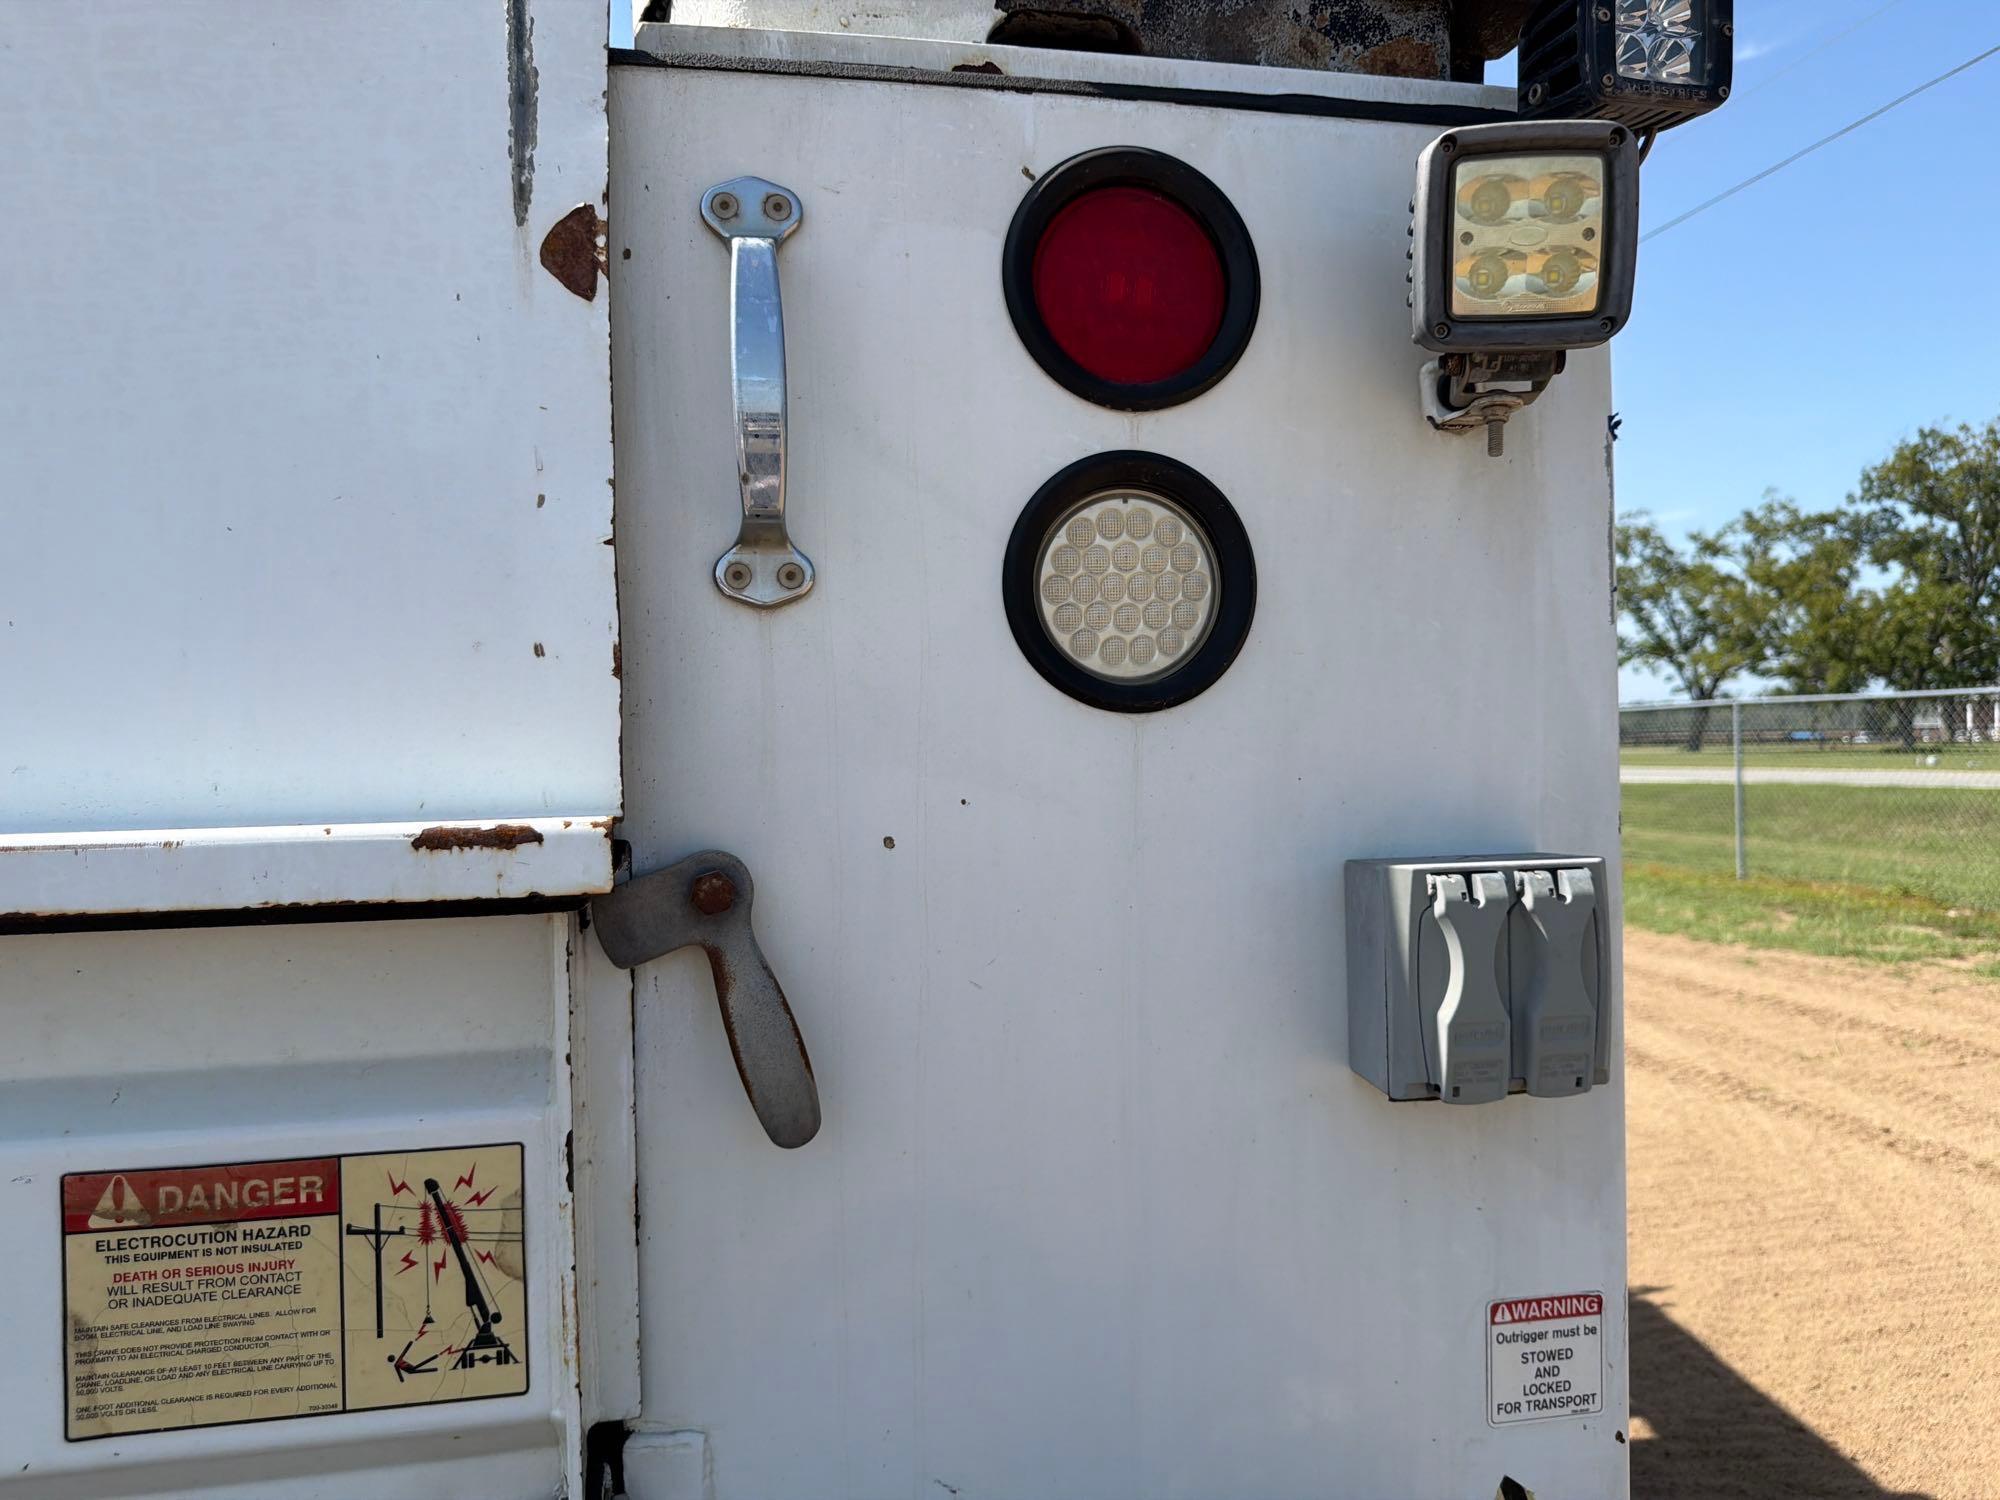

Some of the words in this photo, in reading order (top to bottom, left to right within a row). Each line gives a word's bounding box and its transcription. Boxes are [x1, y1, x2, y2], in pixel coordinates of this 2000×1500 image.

[159, 1175, 324, 1215] DANGER
[96, 1231, 239, 1252] ELECTROCUTION
[243, 1224, 311, 1239] HAZARD
[105, 1254, 130, 1264] THIS
[133, 1249, 200, 1261] EQUIPMENT
[202, 1248, 212, 1256] IS
[215, 1246, 238, 1256] NOT
[241, 1241, 303, 1253] INSULATED
[113, 1271, 157, 1283] DEATH
[162, 1268, 181, 1279] OR
[186, 1264, 244, 1277] SERIOUS
[249, 1259, 296, 1272] INJURY
[107, 1284, 140, 1296] WILL
[142, 1280, 193, 1293] RESULT
[198, 1277, 237, 1290] FROM
[240, 1271, 302, 1285] CONTACT
[108, 1298, 128, 1309] OR
[132, 1292, 217, 1307] INADEQUATE
[222, 1284, 301, 1300] CLEARANCE
[1512, 1298, 1598, 1319] WARNING
[75, 1325, 108, 1335] MAINTAIN
[131, 1319, 179, 1329] CLEARANCES
[204, 1313, 247, 1323] ELECTRICAL
[101, 1330, 144, 1338] ELECTRICAL
[1496, 1330, 1548, 1344] Outrigger
[1553, 1326, 1580, 1338] must
[1584, 1325, 1597, 1335] be
[75, 1356, 115, 1365] PROXIMITY
[140, 1350, 184, 1359] ELECTRICAL
[186, 1346, 221, 1355] CHARGED
[94, 1348, 118, 1357] CRANE
[160, 1342, 192, 1350] PROVIDE
[194, 1338, 241, 1347] PROTECTION
[265, 1332, 298, 1341] CONTACT
[1521, 1348, 1573, 1364] STOWED
[76, 1373, 109, 1382] MAINTAIN
[112, 1368, 155, 1378] CLEARANCE
[233, 1358, 268, 1367] BETWEEN
[286, 1354, 304, 1362] PART
[157, 1373, 177, 1381] LOAD
[212, 1367, 256, 1376] ELECTRICAL
[275, 1361, 311, 1370] CARRYING
[1535, 1365, 1560, 1379] AND
[76, 1406, 91, 1414] ONE
[93, 1403, 114, 1411] FOOT
[115, 1399, 158, 1409] ADDITIONAL
[161, 1395, 204, 1405] CLEARANCE
[215, 1391, 252, 1399] REQUIRED
[271, 1386, 294, 1394] EVERY
[296, 1382, 337, 1391] ADDITIONAL
[1523, 1380, 1571, 1396] LOCKED
[101, 1409, 123, 1417] VOLTS
[1497, 1402, 1521, 1415] FOR
[1526, 1393, 1597, 1411] TRANSPORT
